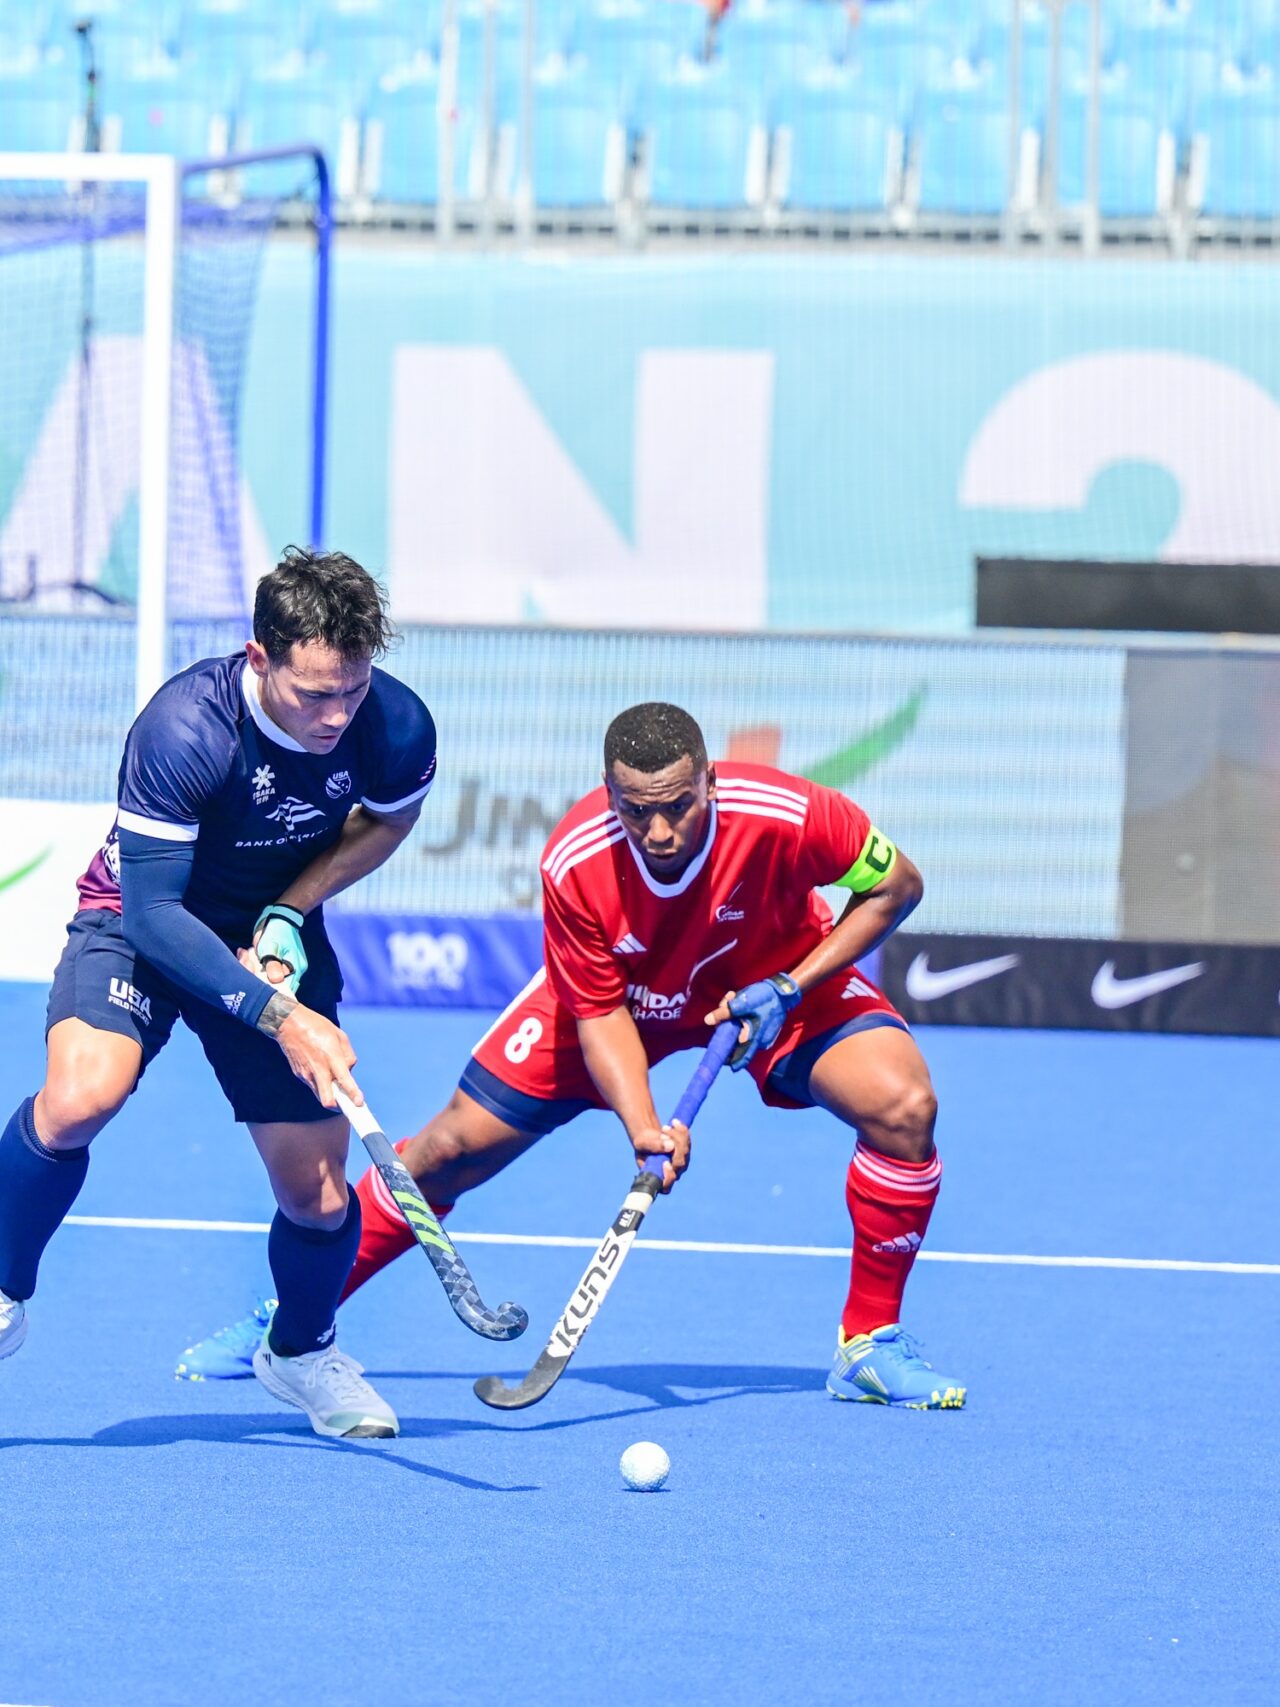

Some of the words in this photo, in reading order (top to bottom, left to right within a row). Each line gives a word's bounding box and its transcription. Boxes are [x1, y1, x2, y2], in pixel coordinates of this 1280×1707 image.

[332, 770, 349, 780] USA
[865, 836, 892, 873] C
[108, 995, 130, 1010] FIELD
[109, 976, 153, 1021] USA
[504, 1017, 543, 1064] 8
